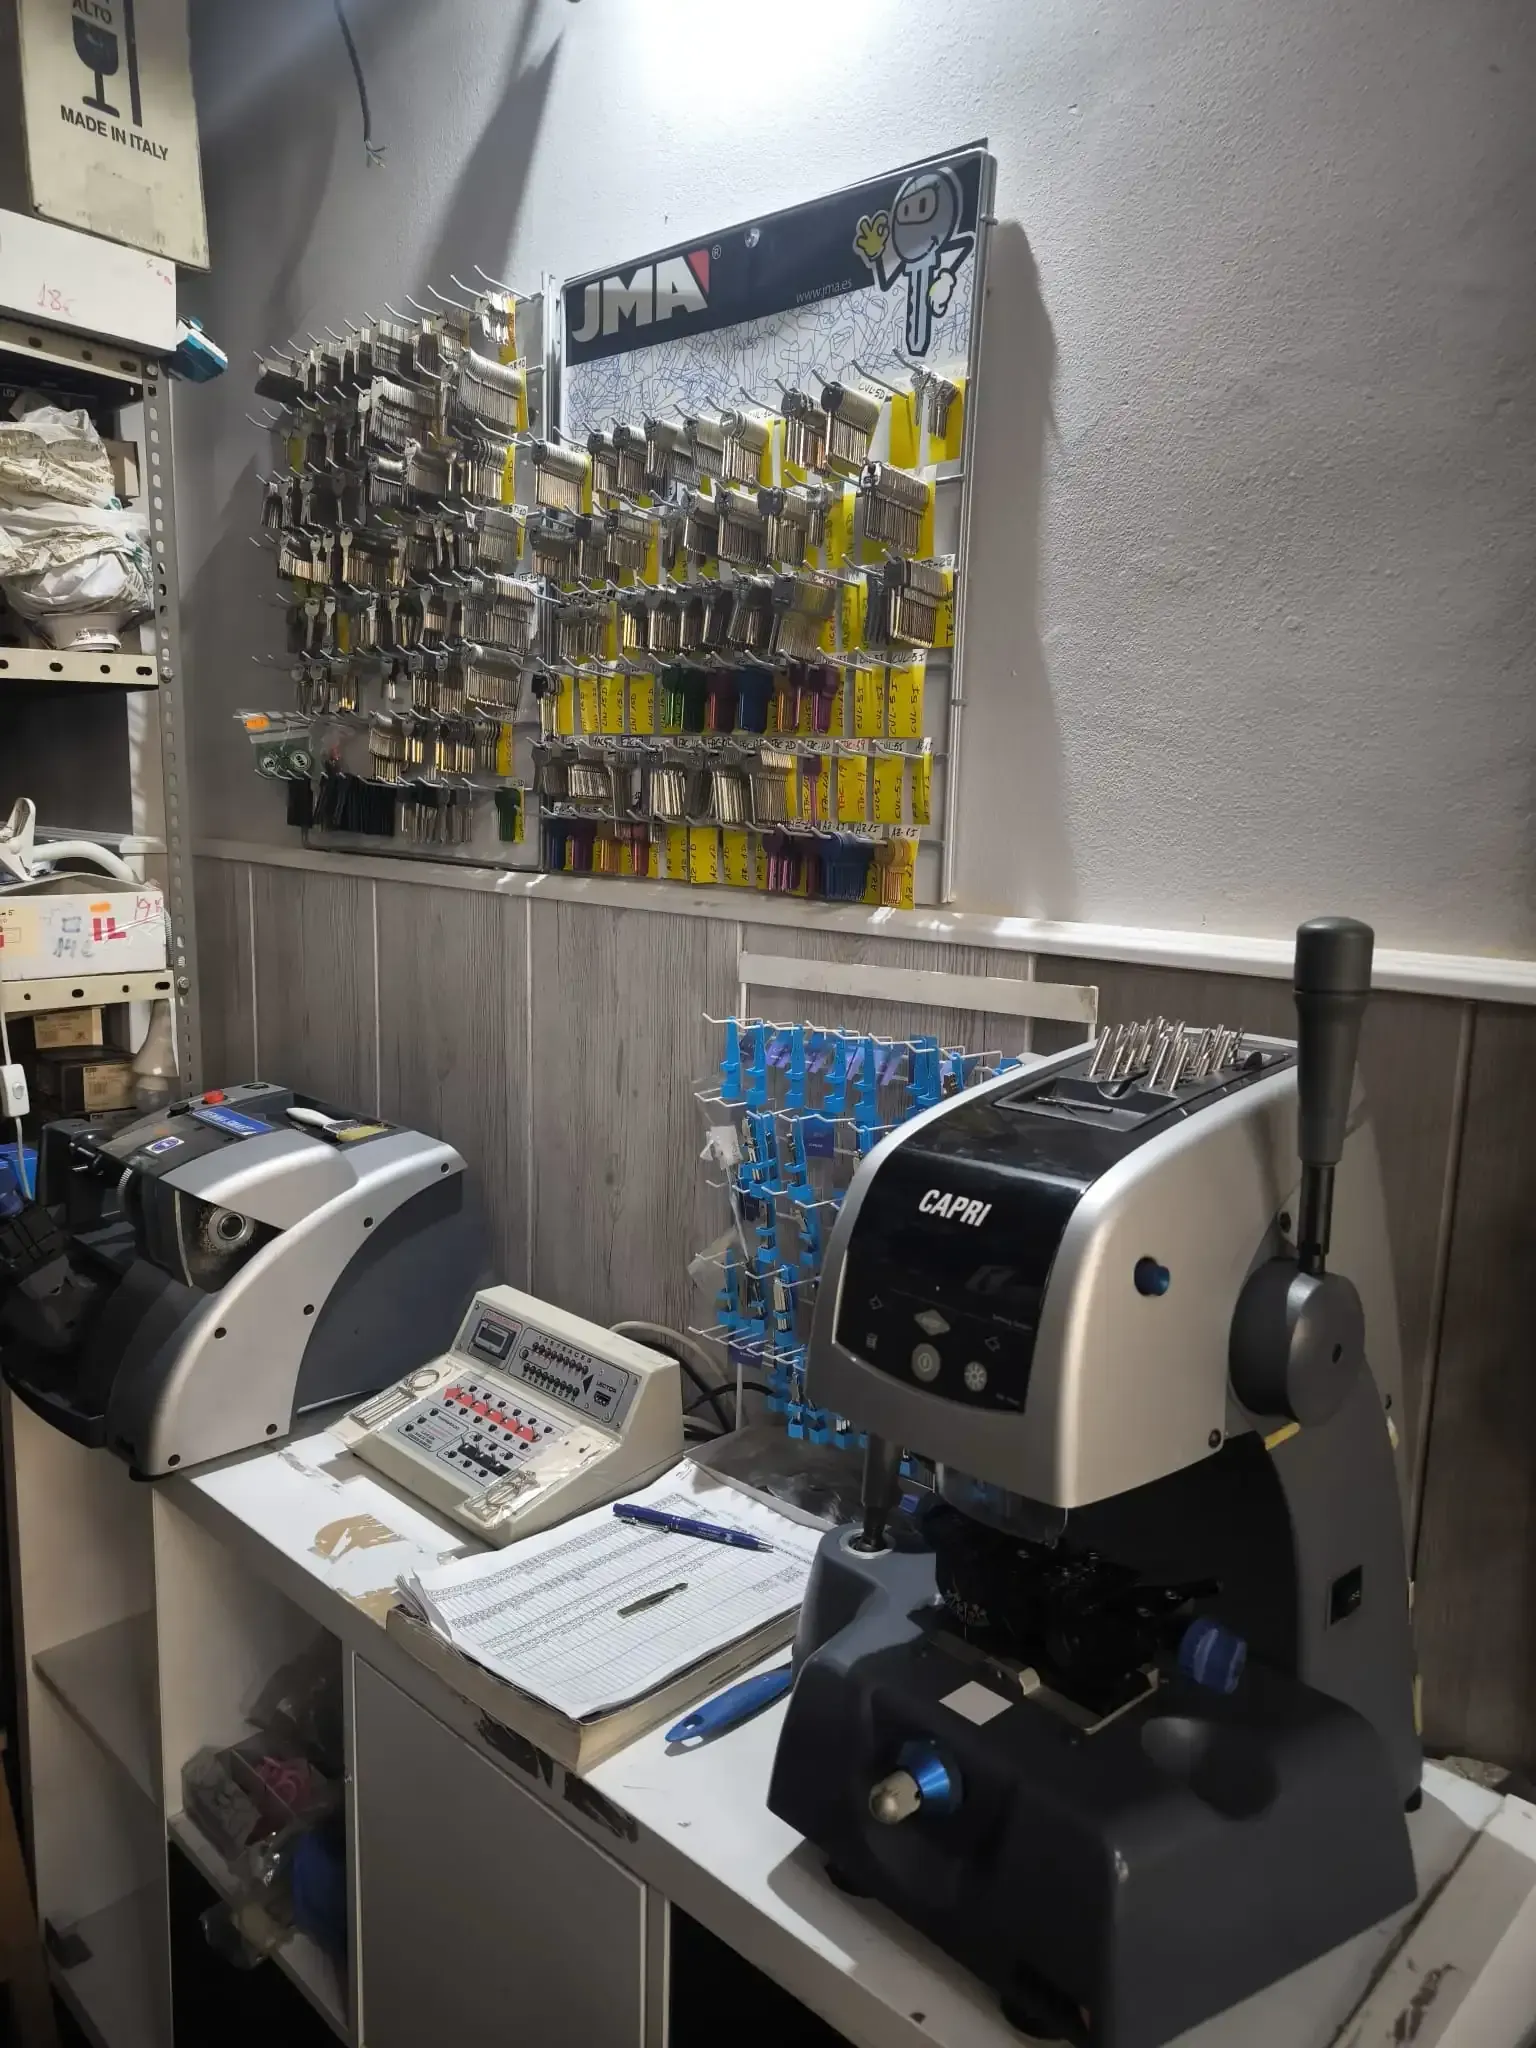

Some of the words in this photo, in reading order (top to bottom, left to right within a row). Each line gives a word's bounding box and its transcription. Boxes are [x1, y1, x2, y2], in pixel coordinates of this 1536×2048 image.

[60, 104, 107, 138] MADE
[111, 126, 126, 146] IN
[129, 134, 168, 161] ITALY
[572, 254, 709, 343] JMA
[796, 278, 853, 303] www.jma.es
[918, 1188, 992, 1227] CAPRI
